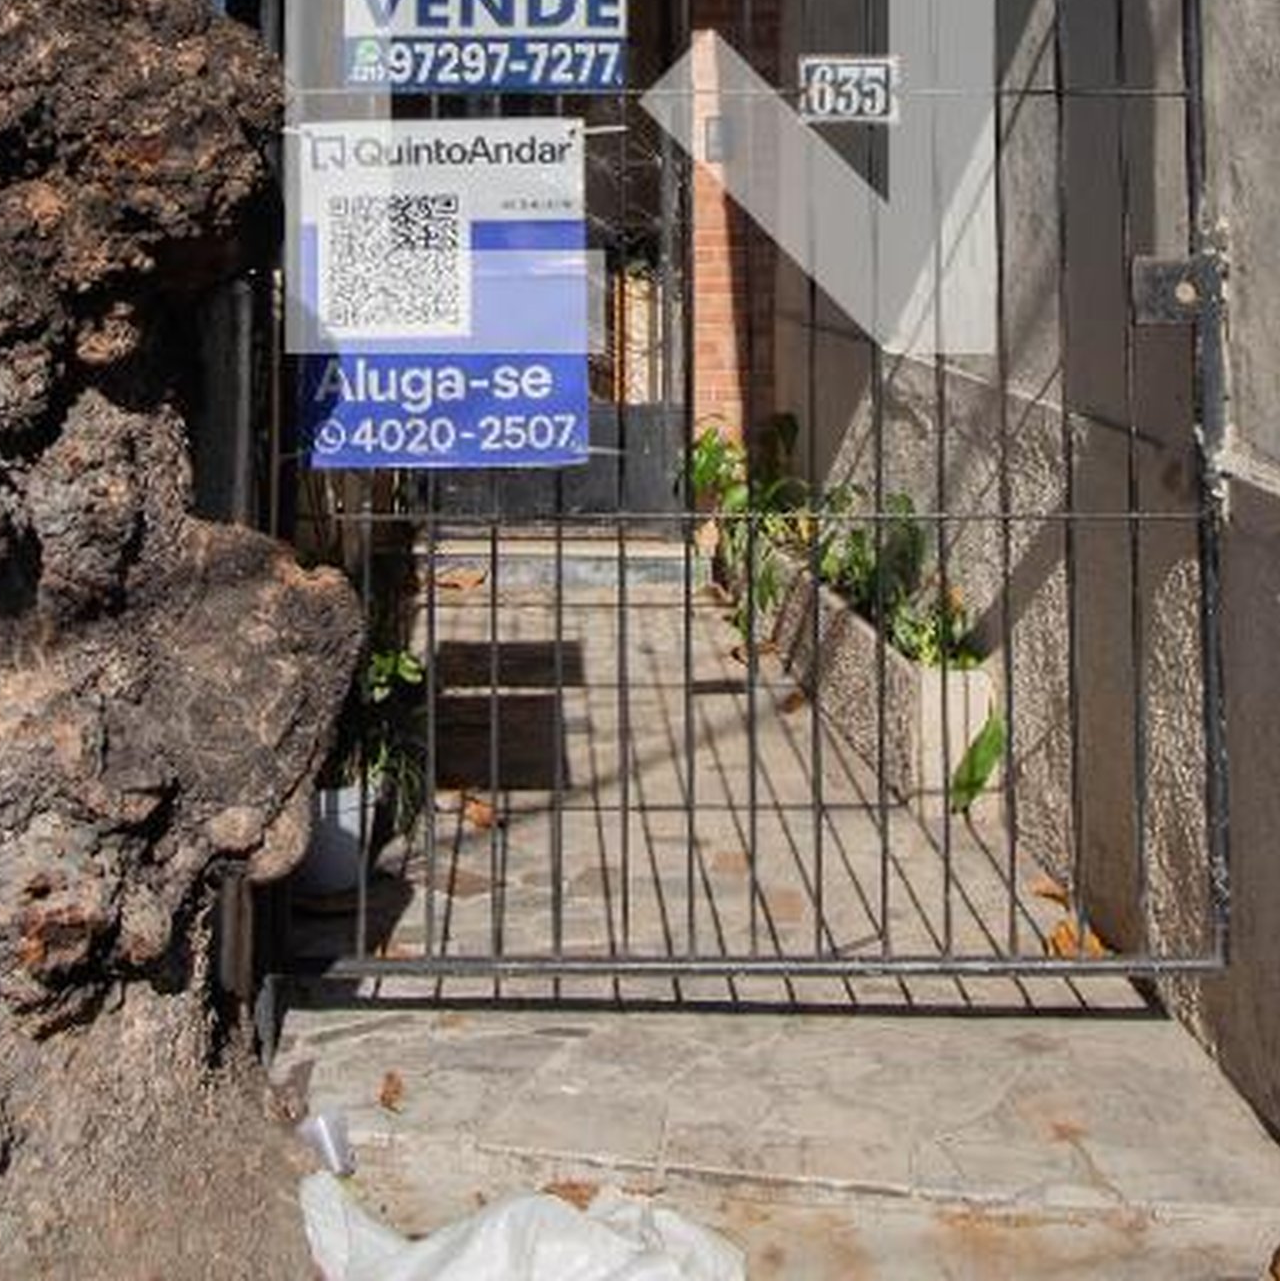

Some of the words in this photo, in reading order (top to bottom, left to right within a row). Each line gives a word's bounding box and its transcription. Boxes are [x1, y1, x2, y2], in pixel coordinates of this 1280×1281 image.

[390, 42, 619, 84] 97297-7277
[354, 134, 572, 167] QuintoAndar
[316, 359, 553, 412] Aluga-se
[353, 414, 578, 454] 4020-2507
